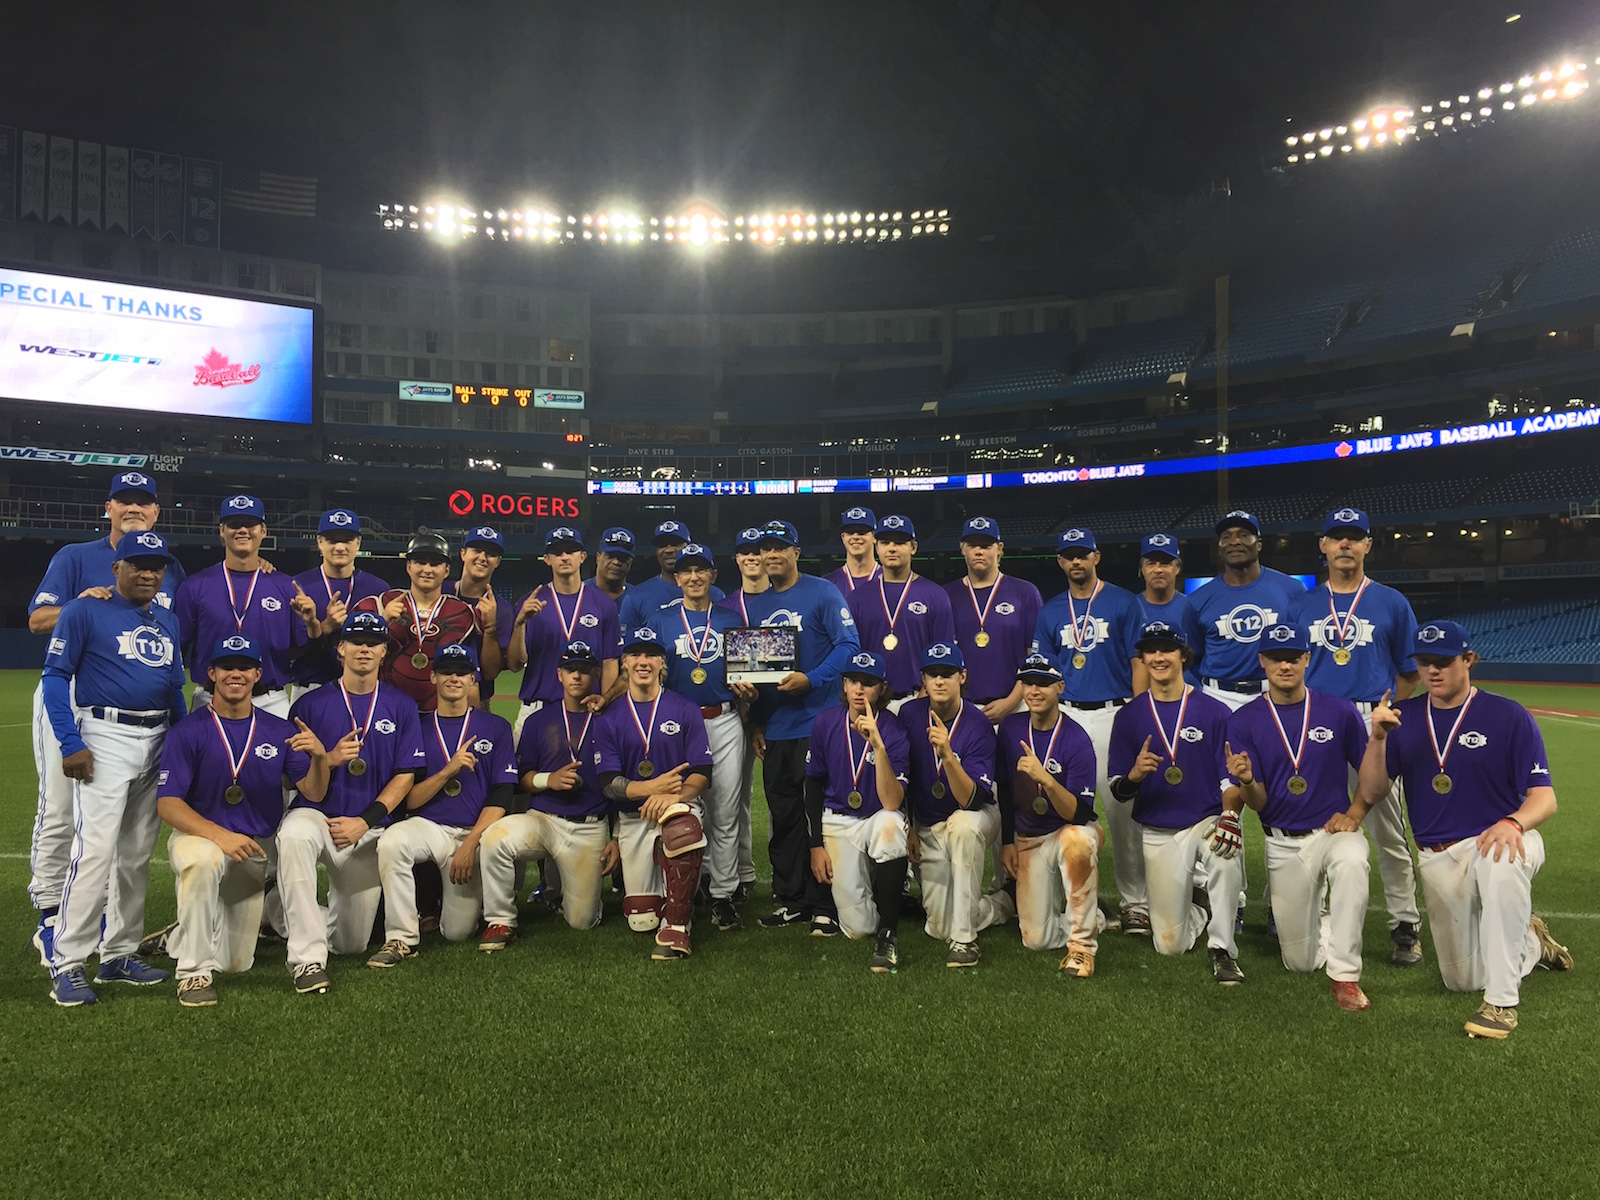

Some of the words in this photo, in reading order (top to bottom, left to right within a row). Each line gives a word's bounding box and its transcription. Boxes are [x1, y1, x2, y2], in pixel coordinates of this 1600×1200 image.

[189, 196, 216, 220] 12
[102, 295, 202, 321] THANKS
[192, 363, 261, 387] Baseball
[455, 386, 476, 395] BALL
[481, 387, 509, 397] STRIKE
[514, 389, 532, 398] OUT
[461, 394, 469, 404] 0
[491, 395, 499, 405] 0
[519, 397, 528, 407] 0
[1077, 428, 1116, 438] ROBERTO
[1120, 422, 1157, 433] ALOMAR
[1356, 437, 1393, 455] BLUE
[1396, 432, 1433, 450] JAYS
[1440, 421, 1516, 445] BASEBALL
[1521, 407, 1600, 434] ACADEMY
[848, 445, 863, 453] PAT
[866, 444, 896, 452] GILLICK
[956, 439, 976, 447] PAUL
[979, 436, 1017, 446] BEESTON
[1, 447, 128, 466] WESTJET
[628, 448, 648, 456] DAVE
[652, 448, 675, 456] STIEB
[738, 447, 757, 455] CITO
[760, 447, 793, 455] GASTON
[149, 454, 185, 465] FLIGHT
[153, 463, 180, 473] DECK
[1022, 470, 1078, 484] TORONTO
[1089, 466, 1115, 480] BLUE
[1117, 464, 1145, 477] JAYS
[481, 493, 579, 518] ROGERS
[1232, 615, 1262, 632] T12
[1325, 624, 1355, 640] T2
[136, 638, 165, 656] T12
